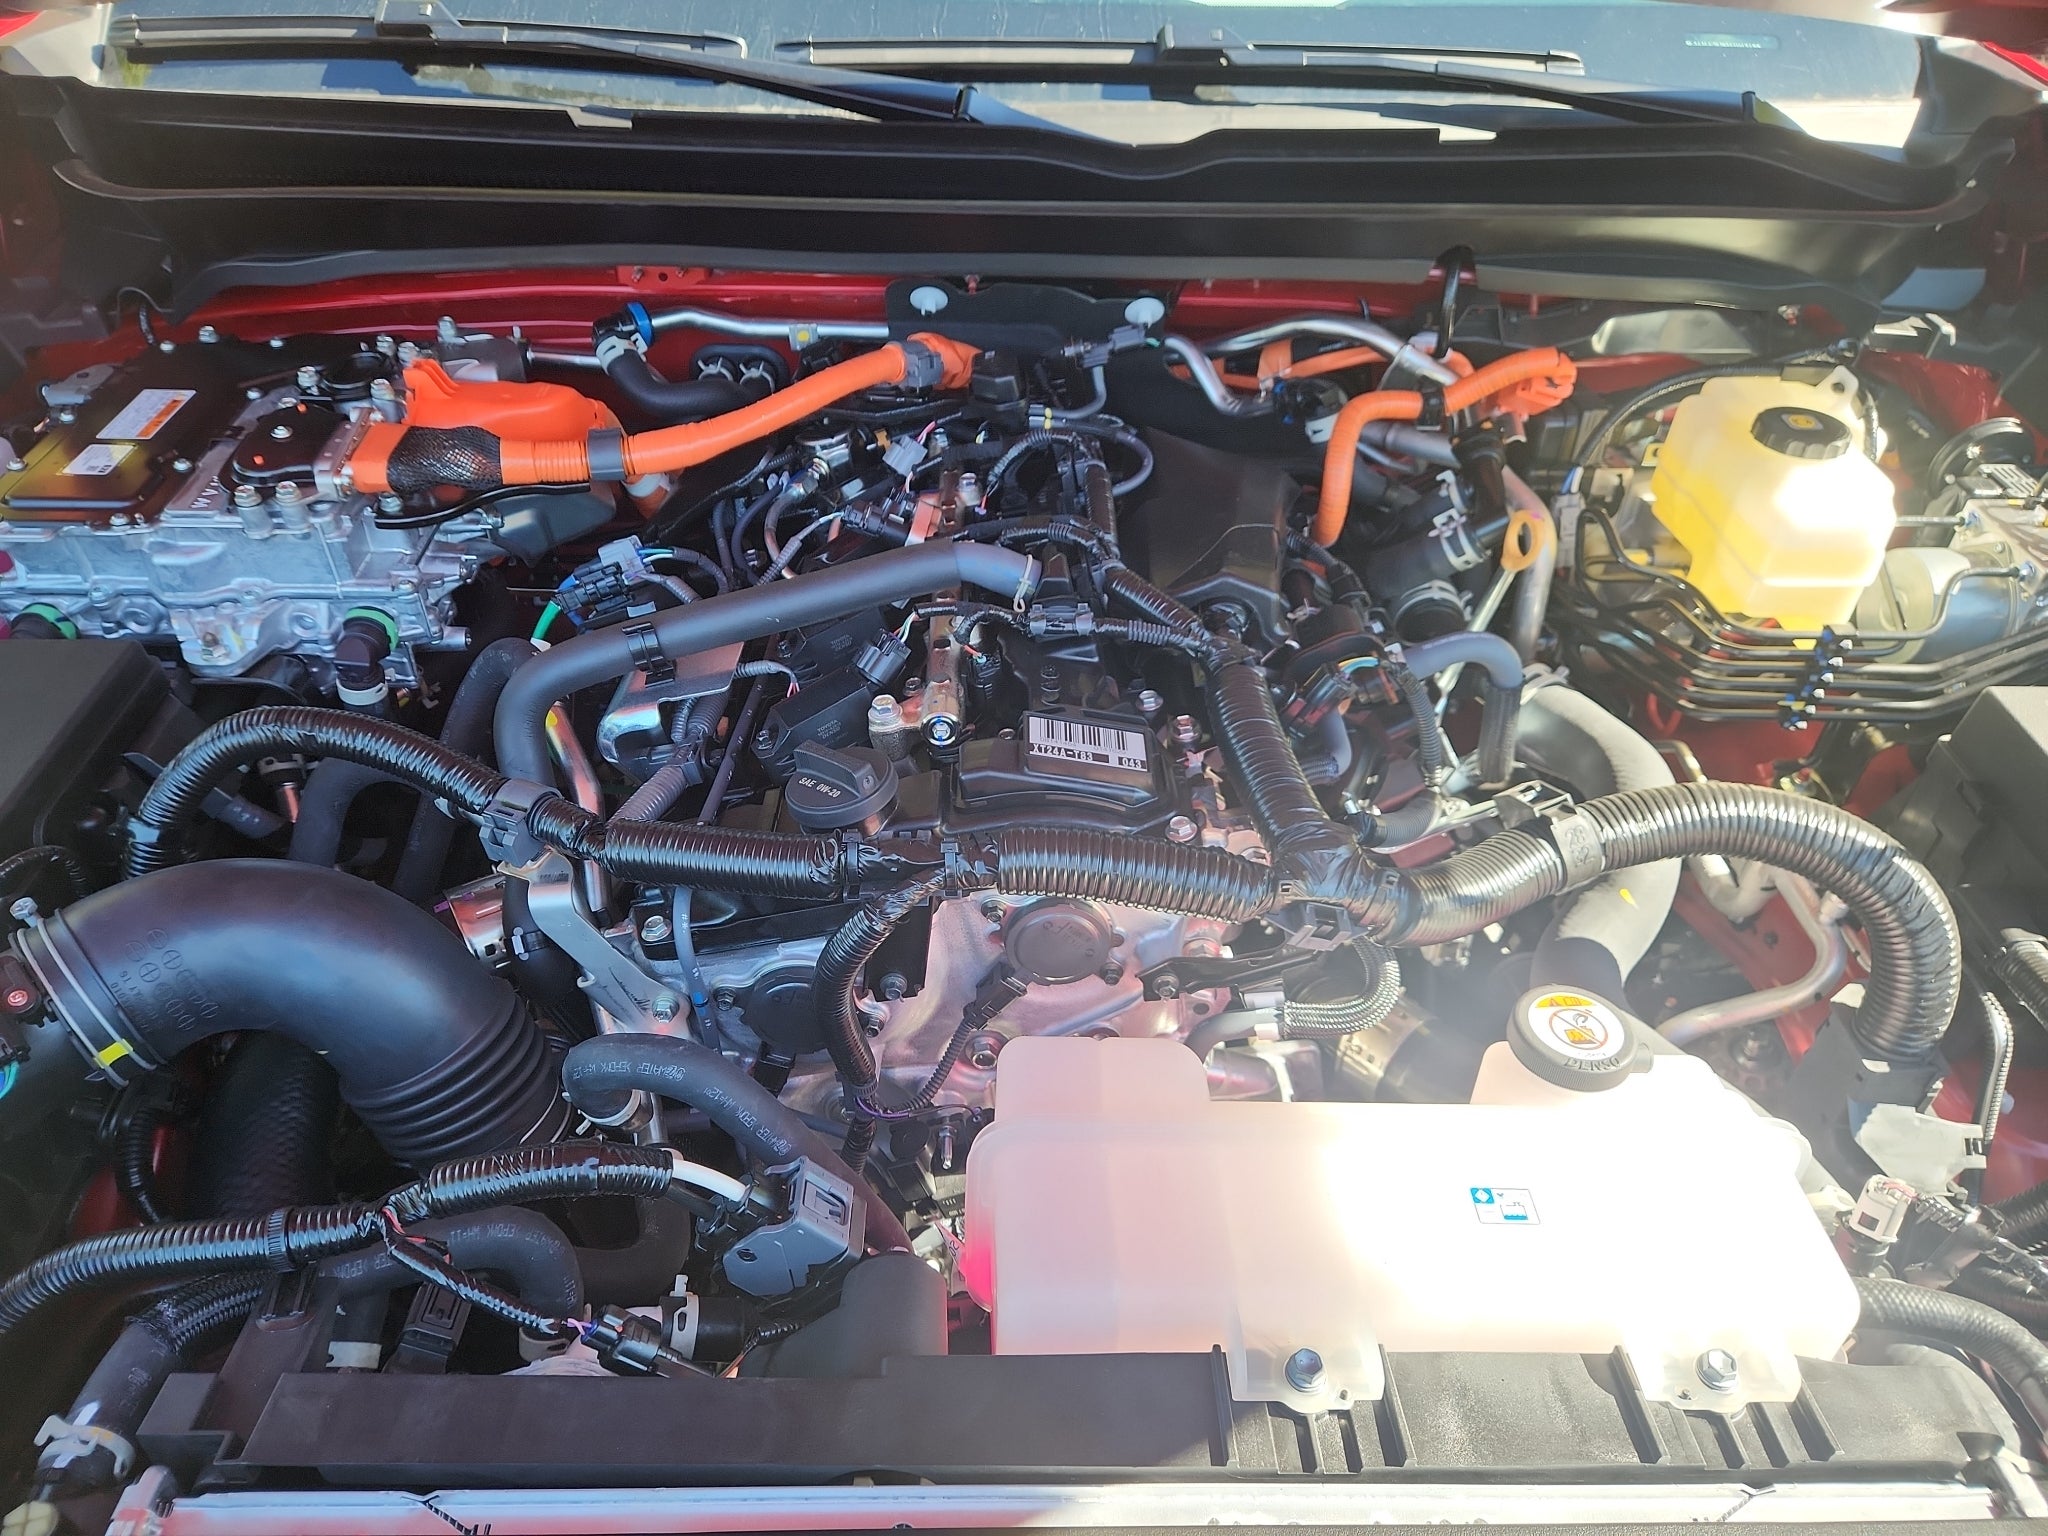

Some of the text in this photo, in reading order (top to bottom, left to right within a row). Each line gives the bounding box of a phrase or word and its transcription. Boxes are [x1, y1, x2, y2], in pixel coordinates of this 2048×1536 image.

[817, 720, 839, 732] TOYOTA
[1033, 743, 1093, 761] XT24A-T83
[1122, 757, 1141, 768] 043
[799, 777, 841, 798] SAE 0W-20
[1564, 1057, 1620, 1072] DENSO
